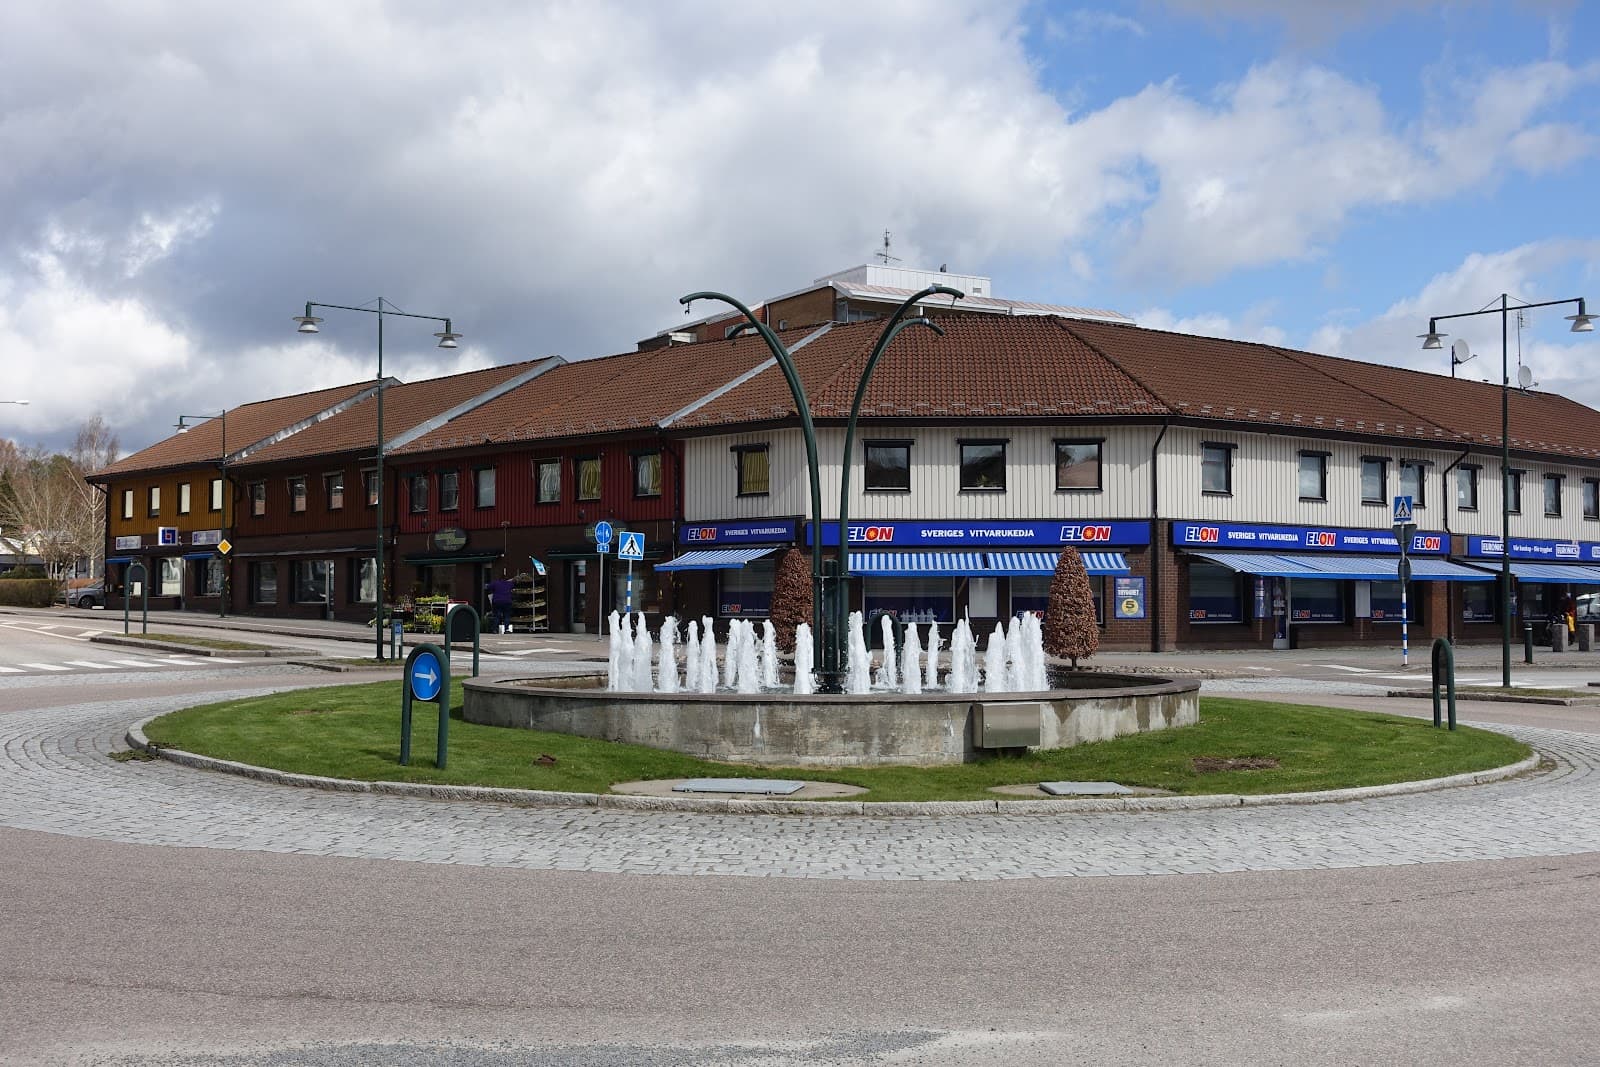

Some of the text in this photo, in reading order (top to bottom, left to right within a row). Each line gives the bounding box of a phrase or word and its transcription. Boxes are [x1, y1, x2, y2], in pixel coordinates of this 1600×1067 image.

[688, 528, 717, 541] ELON
[751, 527, 787, 535] VITVARUKEDJA
[848, 526, 894, 542] ELON
[921, 529, 1034, 538] SVERIGES VITVARUKEDJA
[1060, 525, 1111, 542] ELON
[1185, 526, 1219, 543] ELON
[1228, 531, 1298, 542] SVERIGES VITVARUKEDJA
[1306, 531, 1336, 547] ELON
[1343, 536, 1368, 545] SVERIGES
[1413, 536, 1440, 551] ELON
[1482, 542, 1504, 552] EURONIC
[1125, 600, 1135, 609] 5
